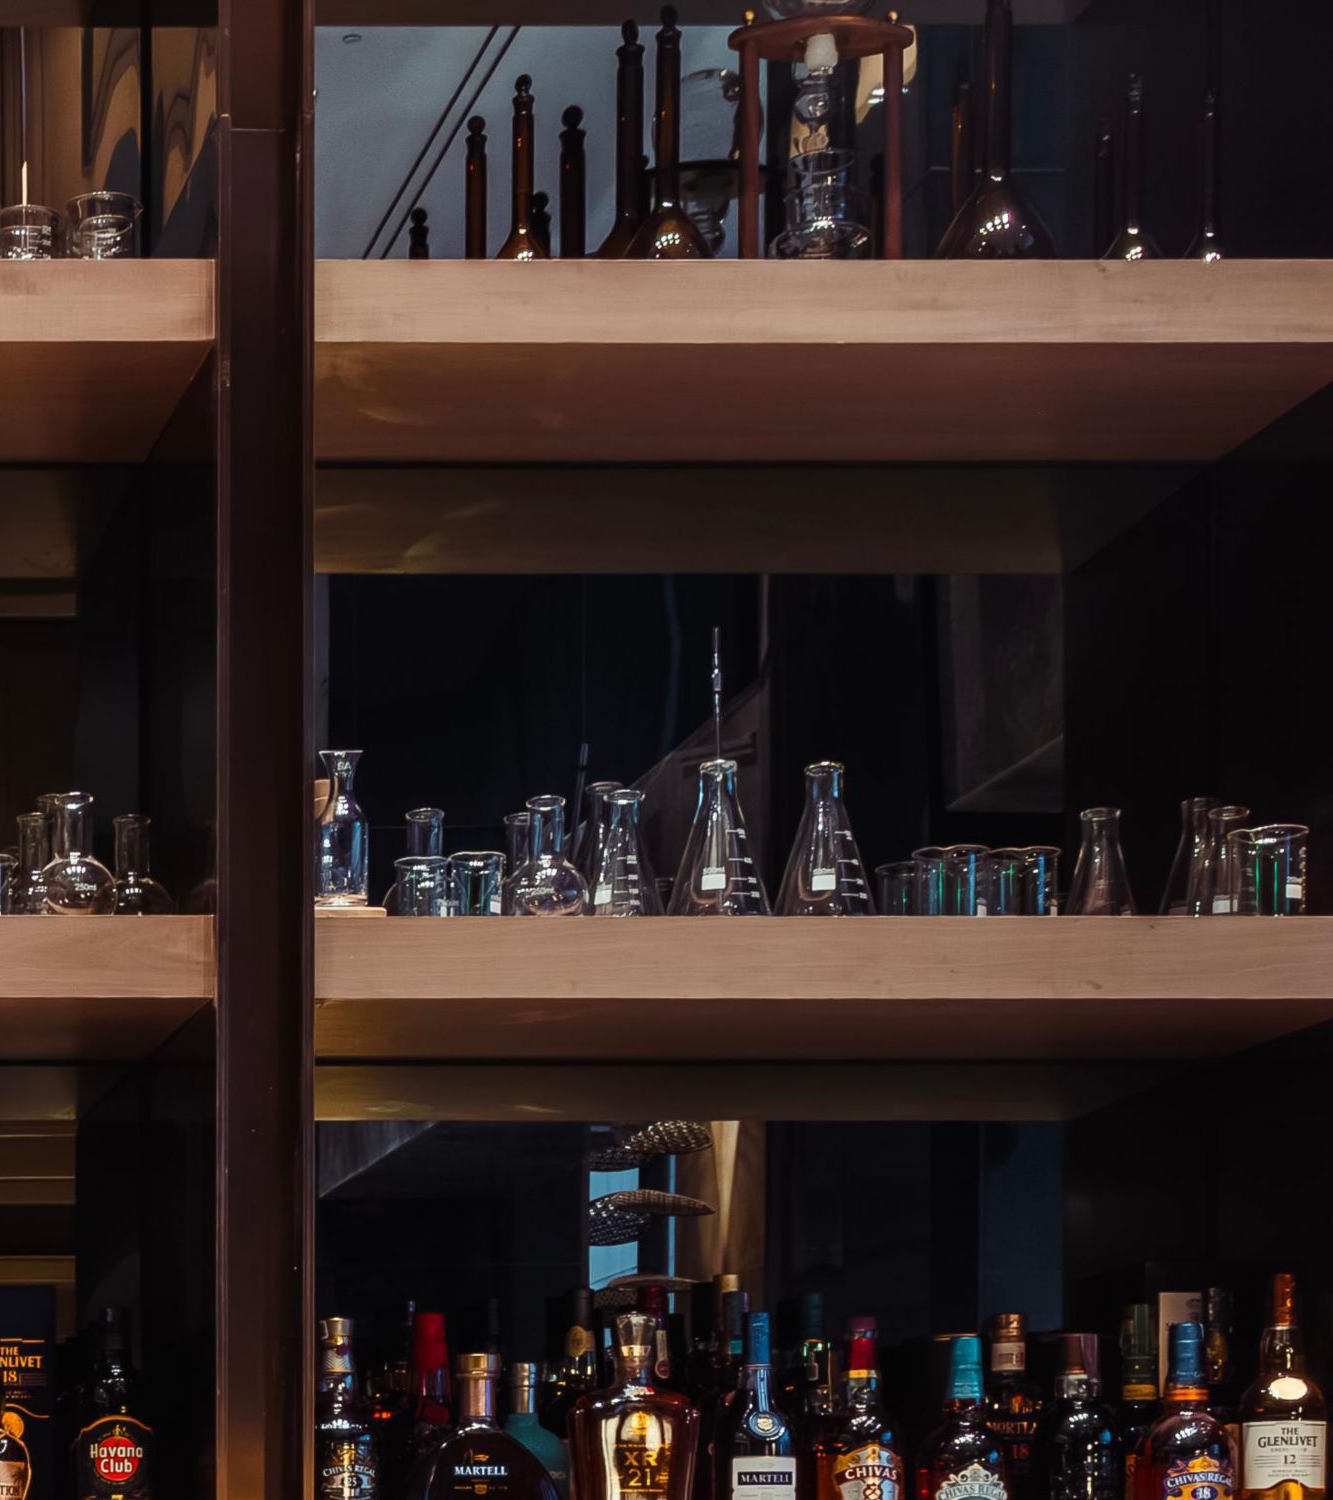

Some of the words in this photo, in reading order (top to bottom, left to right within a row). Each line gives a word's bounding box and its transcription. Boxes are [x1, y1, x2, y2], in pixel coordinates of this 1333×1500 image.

[0, 1346, 19, 1356] THE
[0, 1355, 43, 1368] NLIVET
[2, 1370, 17, 1383] 18
[1281, 1427, 1299, 1436] THE
[1257, 1436, 1318, 1448] GLENLIVET
[89, 1444, 143, 1458] Havana
[100, 1458, 133, 1473] Club
[1284, 1454, 1297, 1465] 12
[323, 1464, 353, 1477] CHIVAS
[354, 1464, 376, 1476] REGAL
[454, 1466, 507, 1476] MARTELL
[628, 1468, 651, 1486] 21
[845, 1466, 897, 1480] CHIVAS
[741, 1474, 790, 1483] MARTELL
[1167, 1472, 1207, 1488] CHIVAS
[1207, 1472, 1233, 1487] REGAL
[939, 1485, 975, 1500] CHIVAS
[1195, 1486, 1211, 1500] 18
